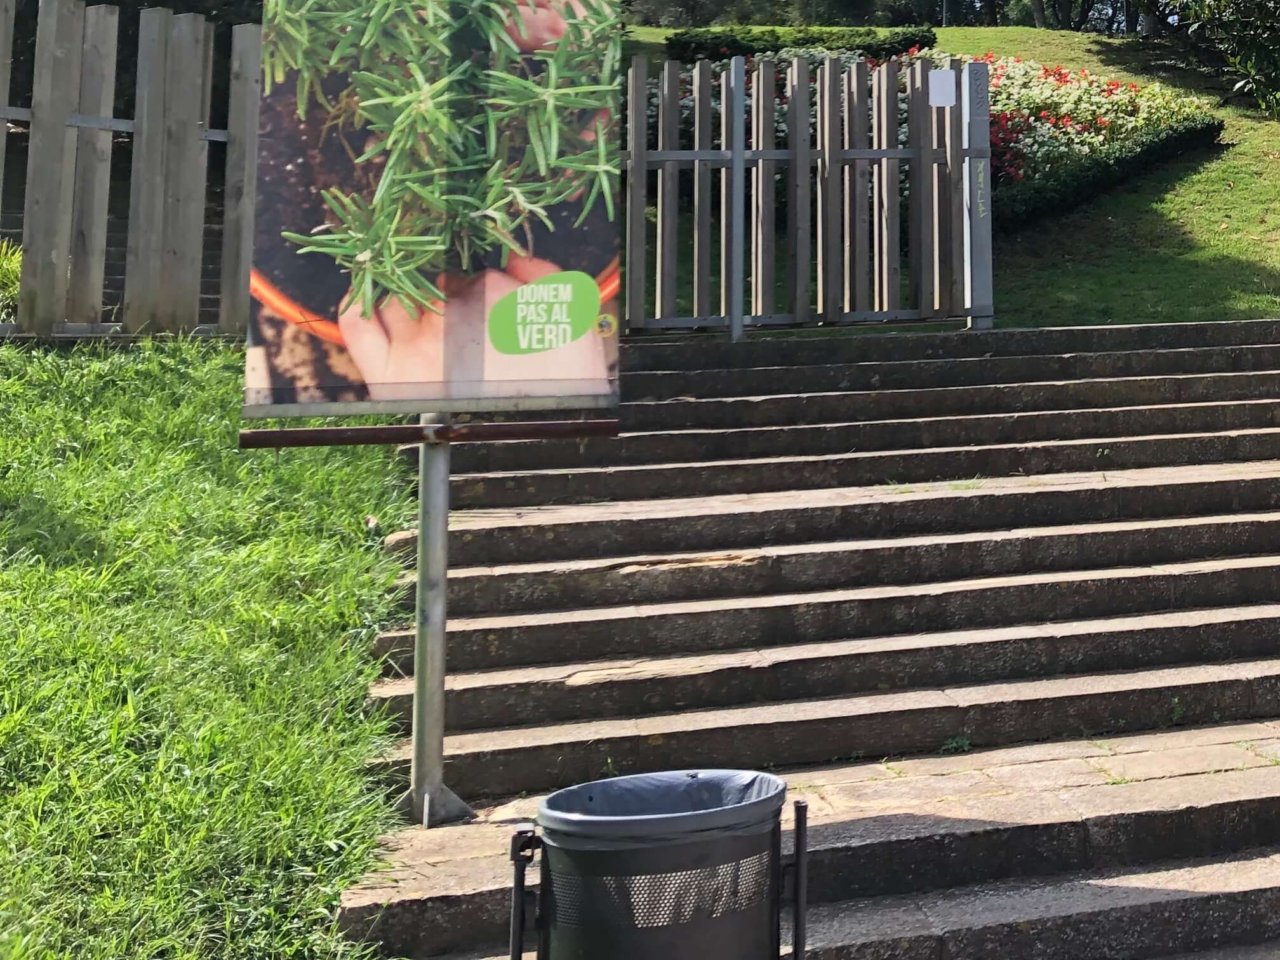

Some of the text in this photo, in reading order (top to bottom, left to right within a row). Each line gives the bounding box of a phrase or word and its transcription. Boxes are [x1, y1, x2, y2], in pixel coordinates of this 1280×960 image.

[516, 283, 573, 303] DONEM
[516, 303, 572, 323] PAS AL
